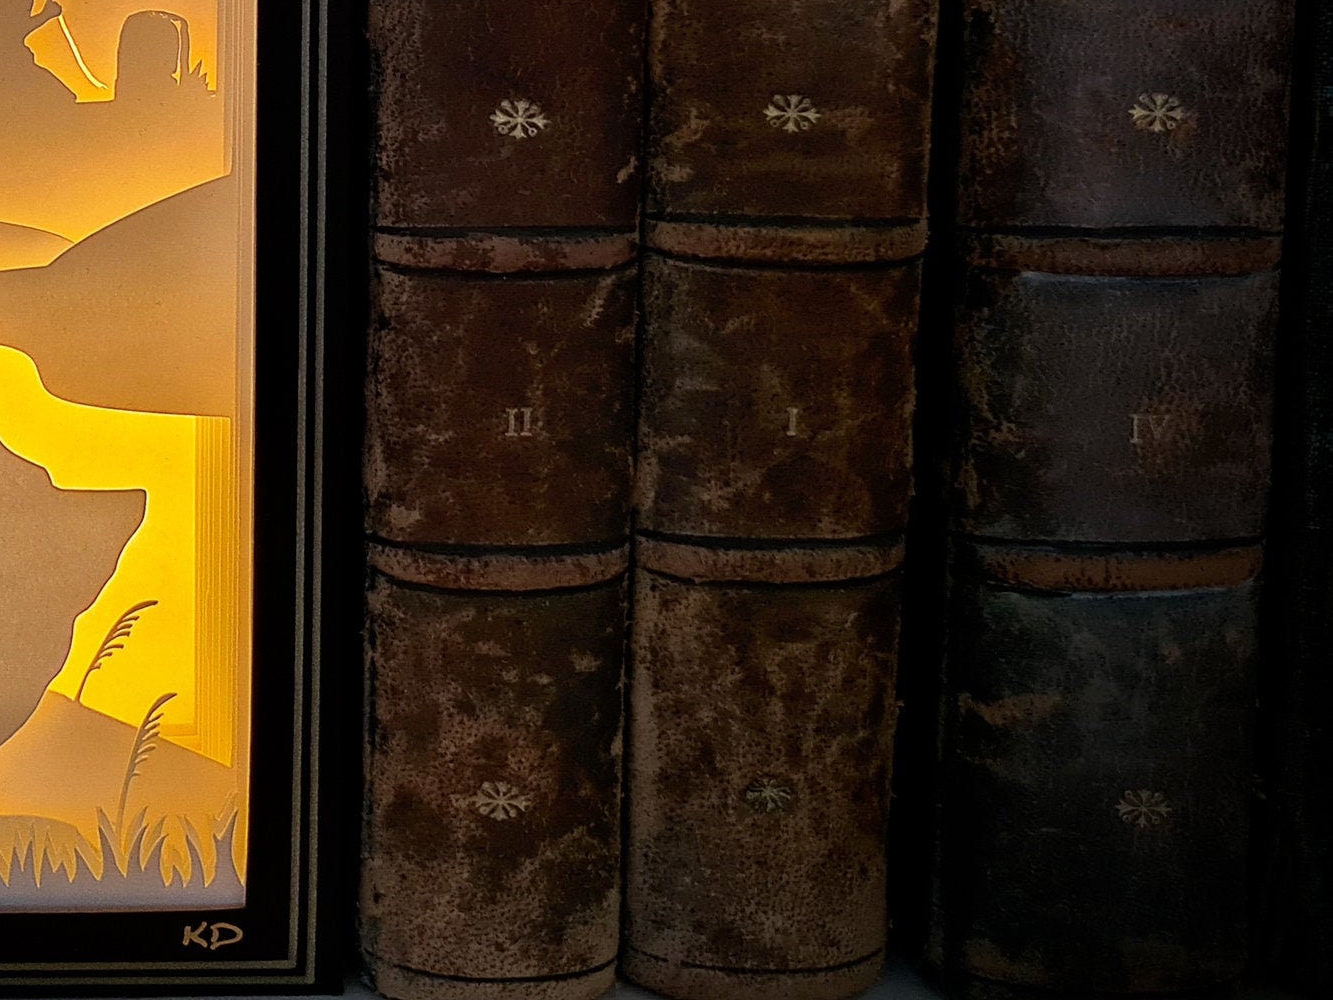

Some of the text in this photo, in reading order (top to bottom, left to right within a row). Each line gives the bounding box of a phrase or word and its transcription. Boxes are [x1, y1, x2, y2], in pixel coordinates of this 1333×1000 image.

[505, 407, 533, 437] II
[786, 406, 799, 436] I
[182, 921, 243, 950] KD
